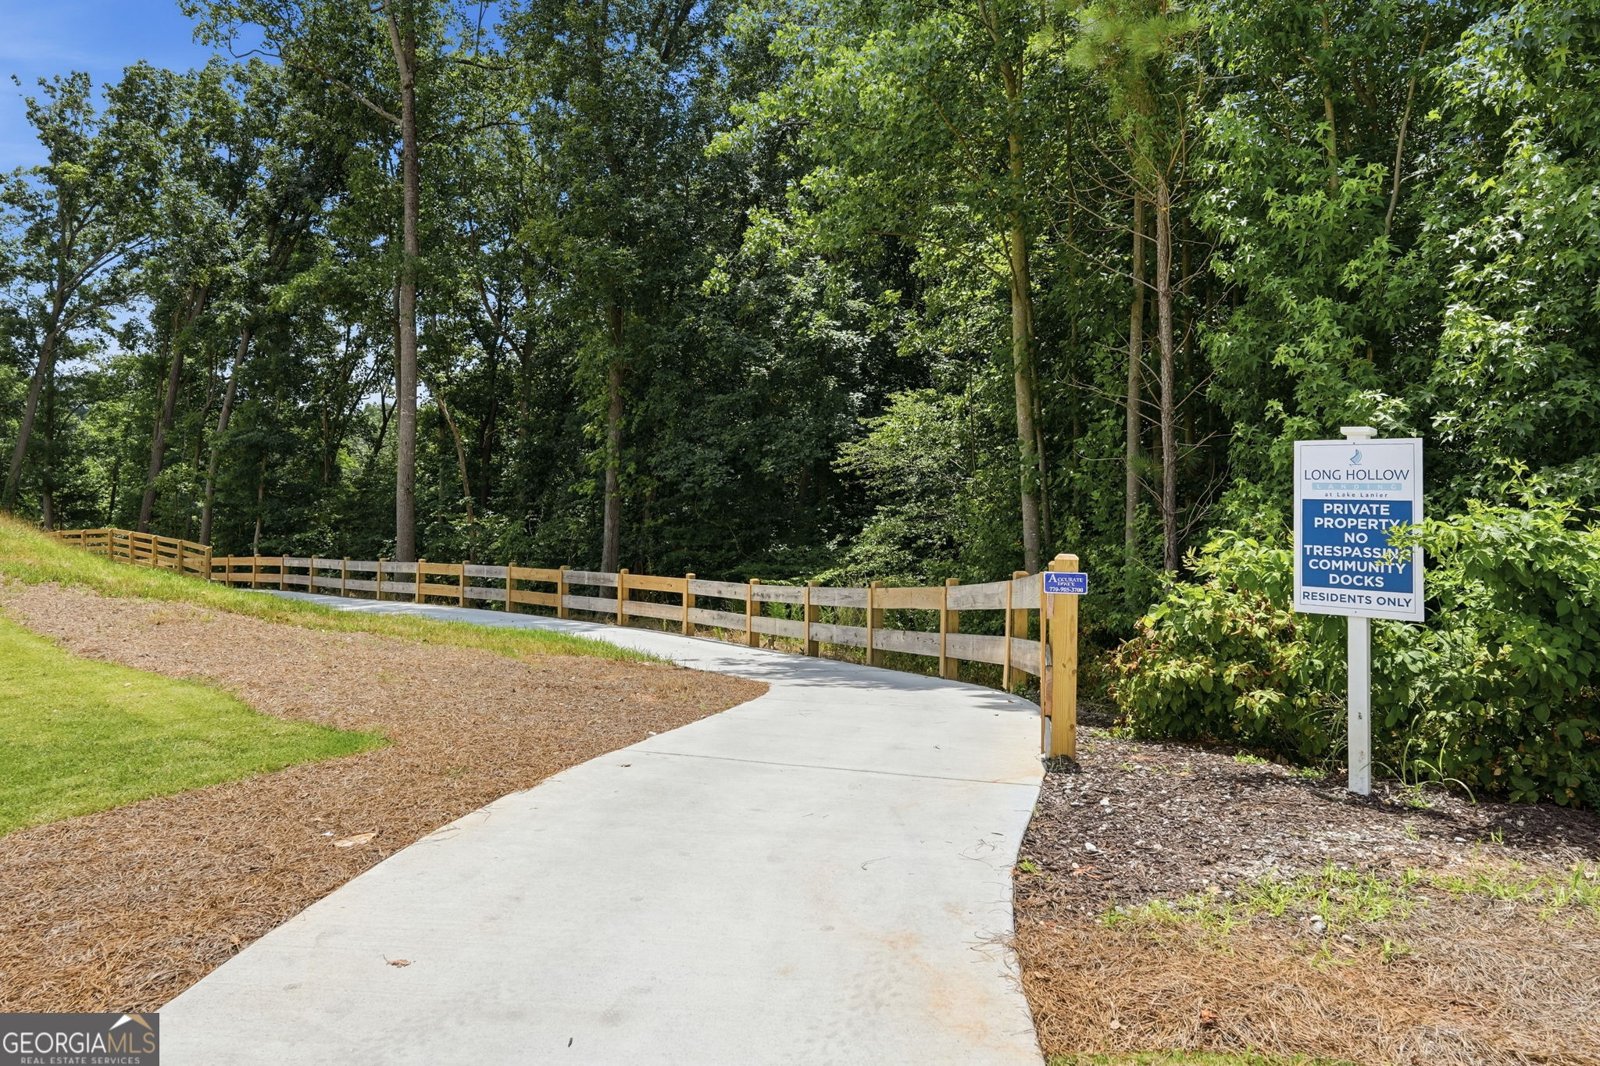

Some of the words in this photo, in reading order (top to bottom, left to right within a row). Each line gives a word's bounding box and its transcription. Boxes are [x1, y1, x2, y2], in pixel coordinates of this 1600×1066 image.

[1304, 469, 1341, 480] LONG
[1346, 469, 1410, 480] HOLLOW
[1323, 503, 1390, 515] PRIVATE
[1314, 517, 1400, 530] PROPERTY
[1344, 532, 1368, 543] NO
[1304, 545, 1411, 560] TRESPASSIN
[1308, 559, 1406, 574] COMMUNITY
[1329, 574, 1384, 588] DOCKS
[1302, 591, 1372, 604] RESIDENTS
[1376, 596, 1412, 607] ONLY
